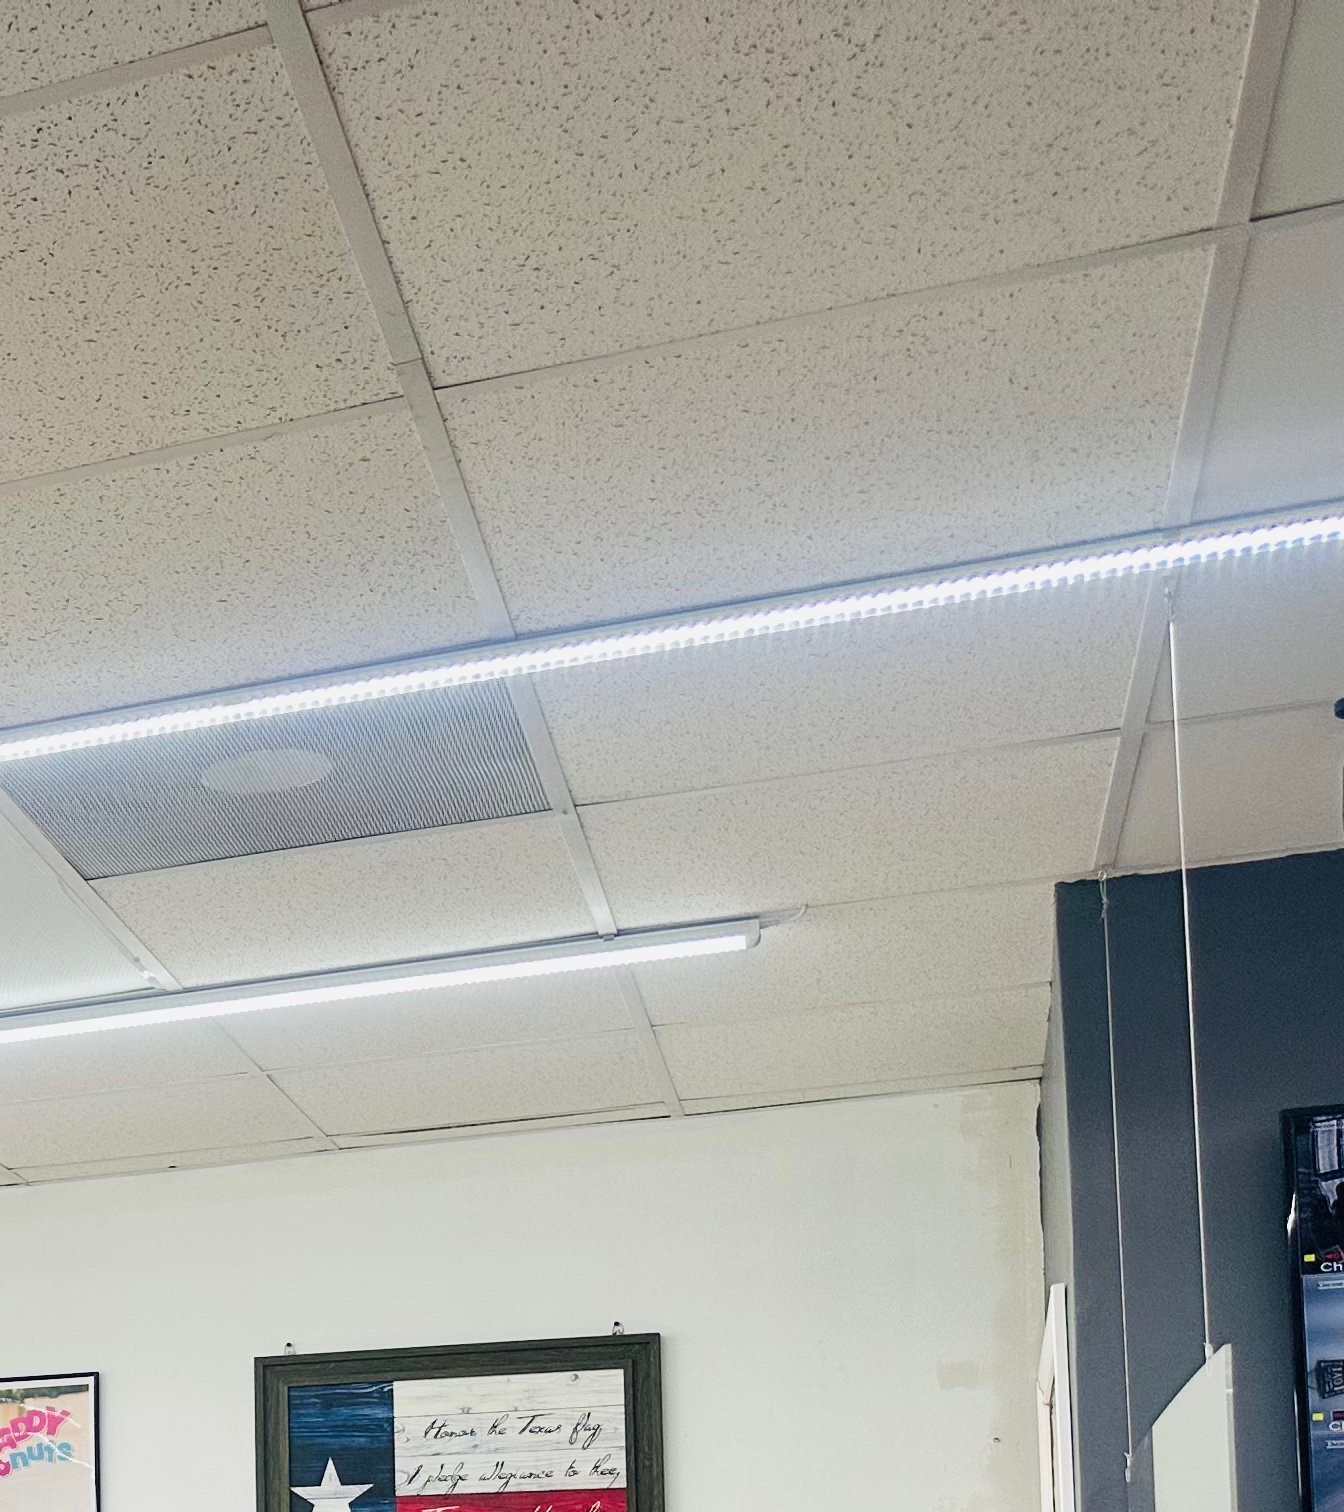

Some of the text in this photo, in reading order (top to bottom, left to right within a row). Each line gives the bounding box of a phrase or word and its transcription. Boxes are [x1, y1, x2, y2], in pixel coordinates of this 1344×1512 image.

[423, 1418, 478, 1440] Honor
[487, 1414, 510, 1437] the
[516, 1412, 563, 1435] Texas
[416, 1462, 469, 1496] pledge
[478, 1460, 554, 1493] allegiance
[564, 1459, 580, 1478] to
